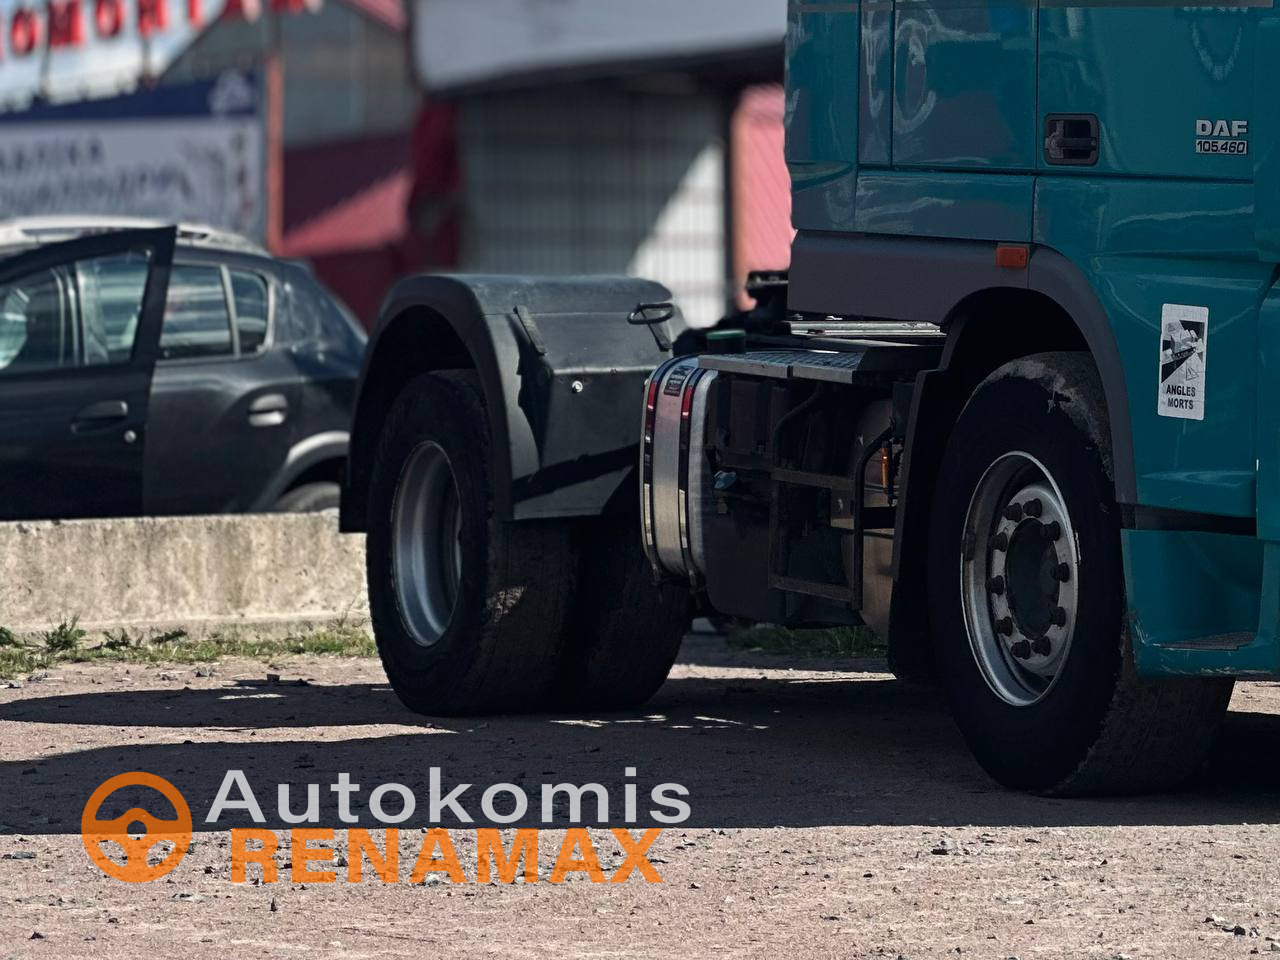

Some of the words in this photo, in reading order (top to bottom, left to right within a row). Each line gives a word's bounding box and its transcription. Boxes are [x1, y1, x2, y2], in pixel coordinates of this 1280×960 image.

[1195, 119, 1249, 137] DAF
[1196, 140, 1247, 154] 105.460
[1166, 384, 1196, 398] ANGLES
[1167, 397, 1194, 410] MORTS
